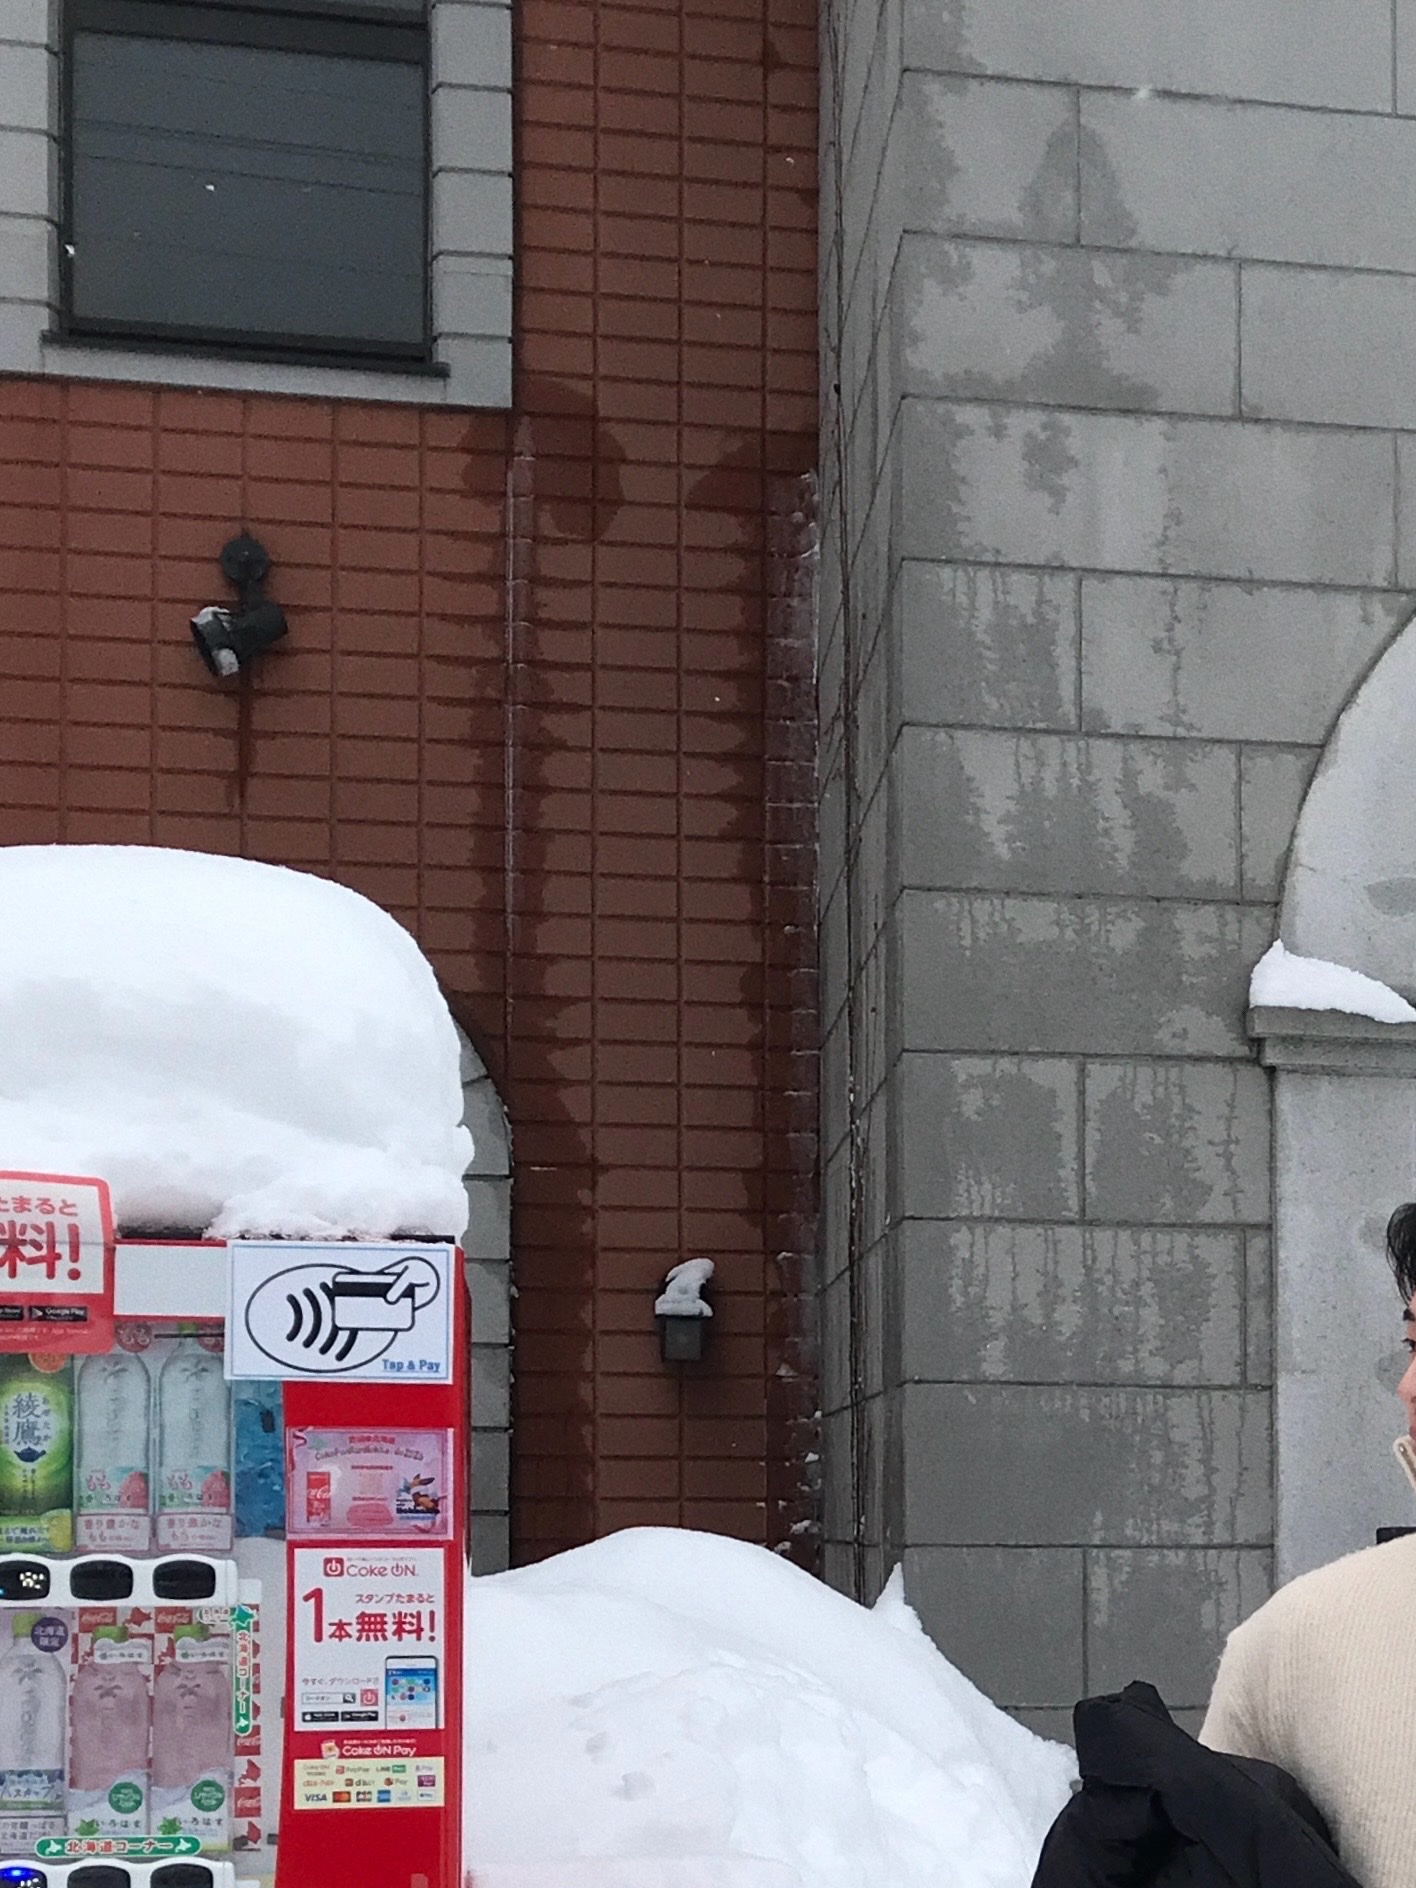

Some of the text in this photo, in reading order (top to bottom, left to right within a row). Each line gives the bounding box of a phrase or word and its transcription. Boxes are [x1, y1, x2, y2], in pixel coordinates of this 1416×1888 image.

[382, 1359, 441, 1373] Tap & Pay
[346, 1562, 417, 1578] Coke ON
[355, 1592, 436, 1604] スタンプたまると
[342, 1744, 417, 1758] Coke ON Pay
[305, 1793, 328, 1802] VISA
[65, 1838, 173, 1853] 北海道コーナー
